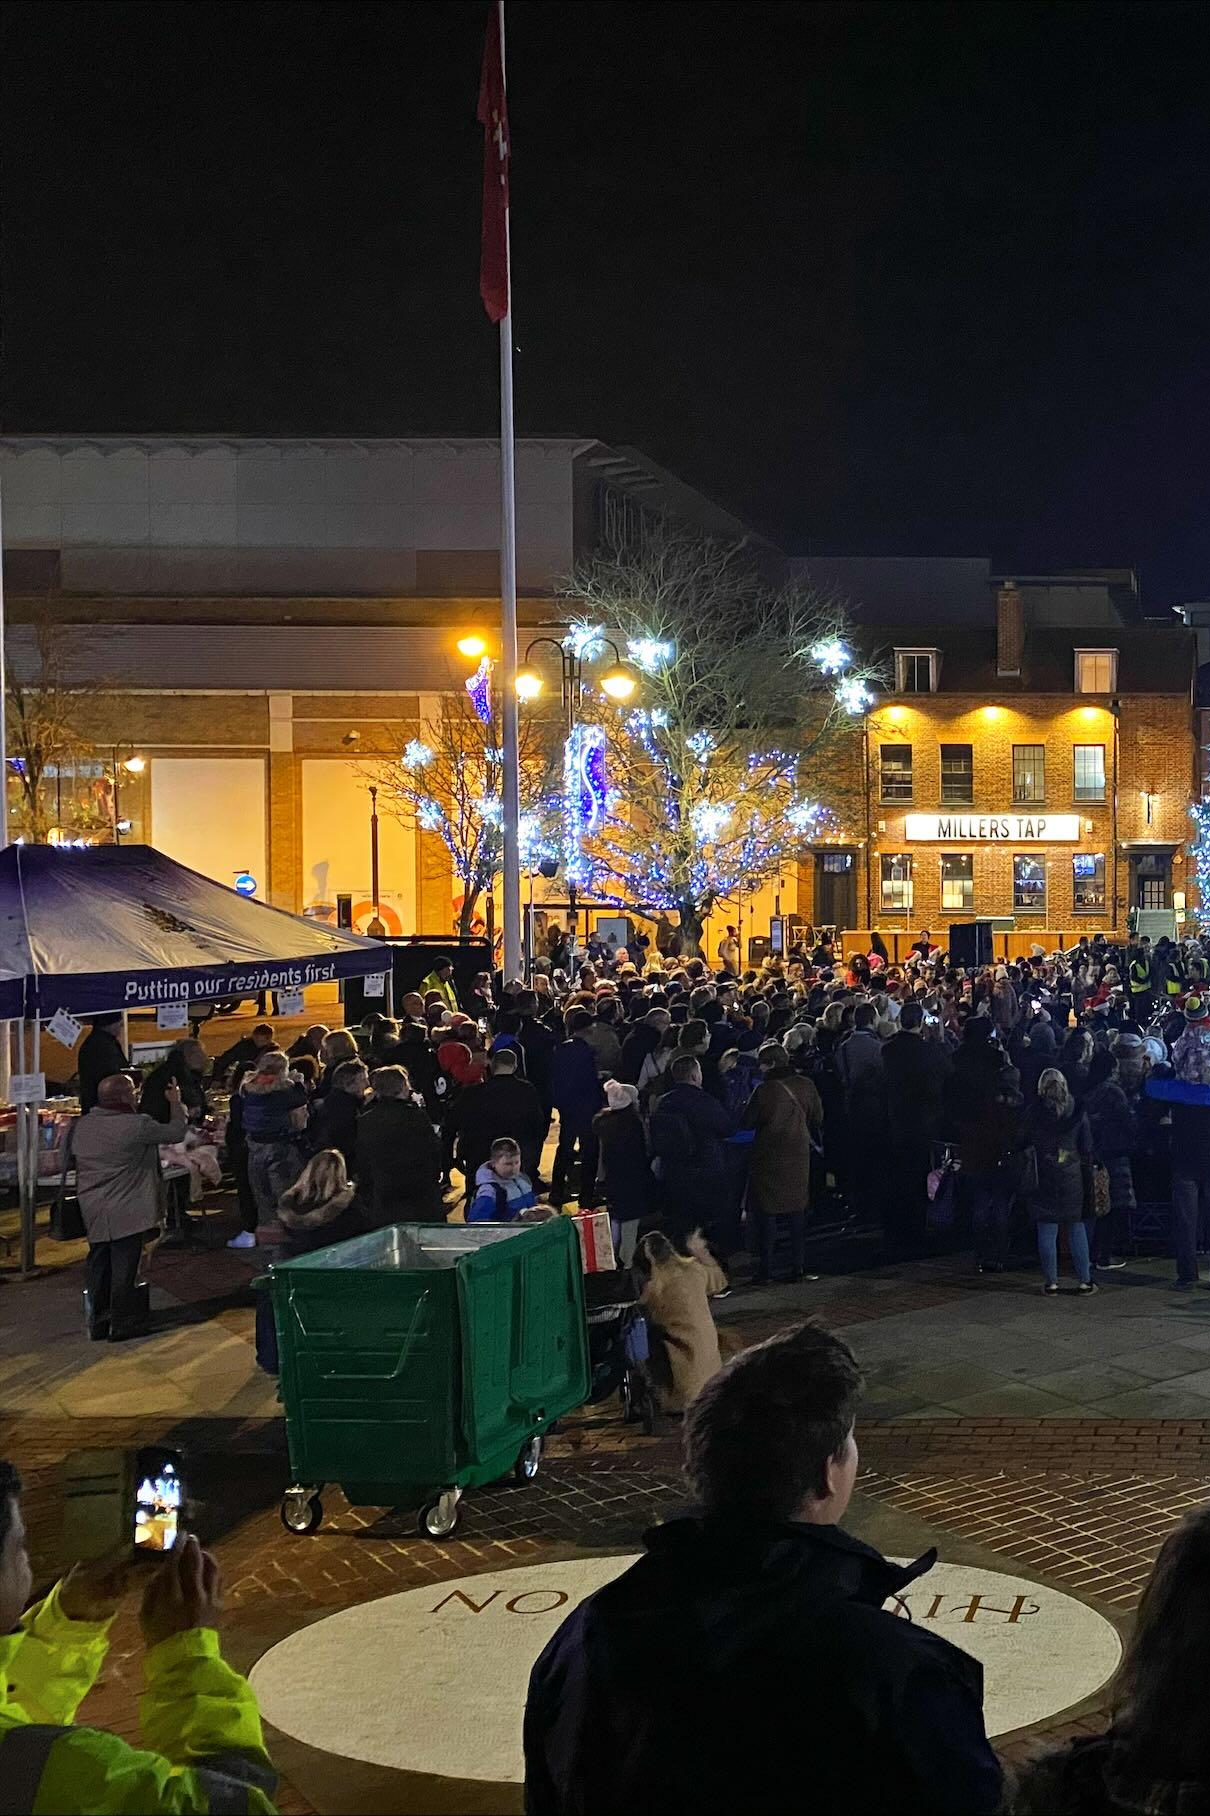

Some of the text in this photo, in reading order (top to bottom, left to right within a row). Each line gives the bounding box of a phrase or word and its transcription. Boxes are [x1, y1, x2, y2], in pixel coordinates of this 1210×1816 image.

[937, 818, 1047, 838] MILLERS TAP
[125, 962, 336, 1001] Putting our residents first
